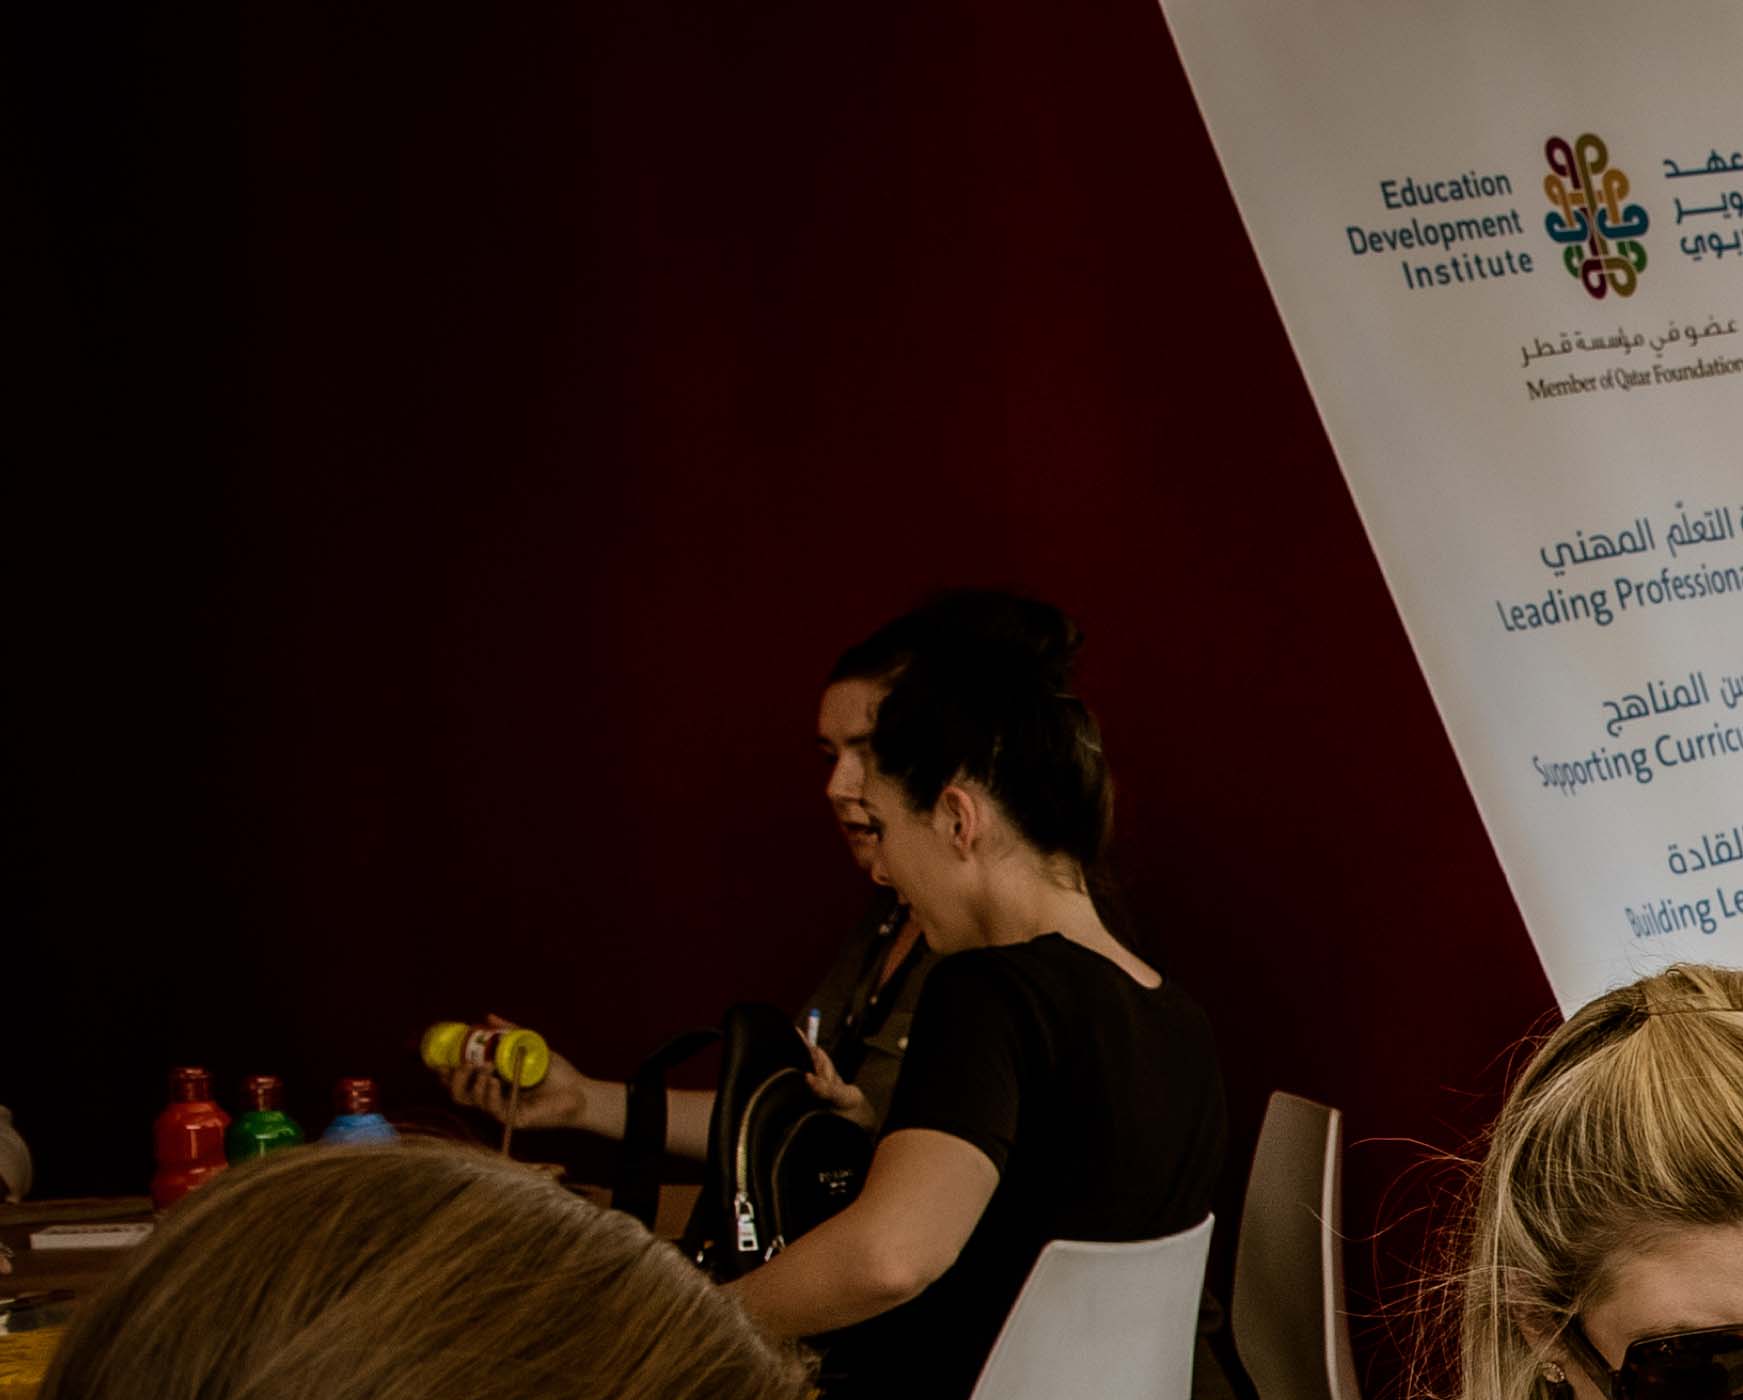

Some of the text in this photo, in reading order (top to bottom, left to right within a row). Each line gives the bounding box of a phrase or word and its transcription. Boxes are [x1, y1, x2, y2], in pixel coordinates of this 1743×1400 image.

[1380, 171, 1512, 210] Education
[1346, 209, 1523, 255] Development
[1402, 248, 1534, 289] Institute
[1521, 336, 1573, 368] قطر
[1527, 372, 1598, 401] Member
[1600, 371, 1615, 392] of
[1615, 367, 1652, 393] Qatar
[1540, 518, 1655, 577] المهني
[1496, 585, 1614, 632] Leading
[1602, 673, 1710, 737] المناهج
[1531, 748, 1653, 797] Supporting
[1625, 897, 1717, 939] Building
